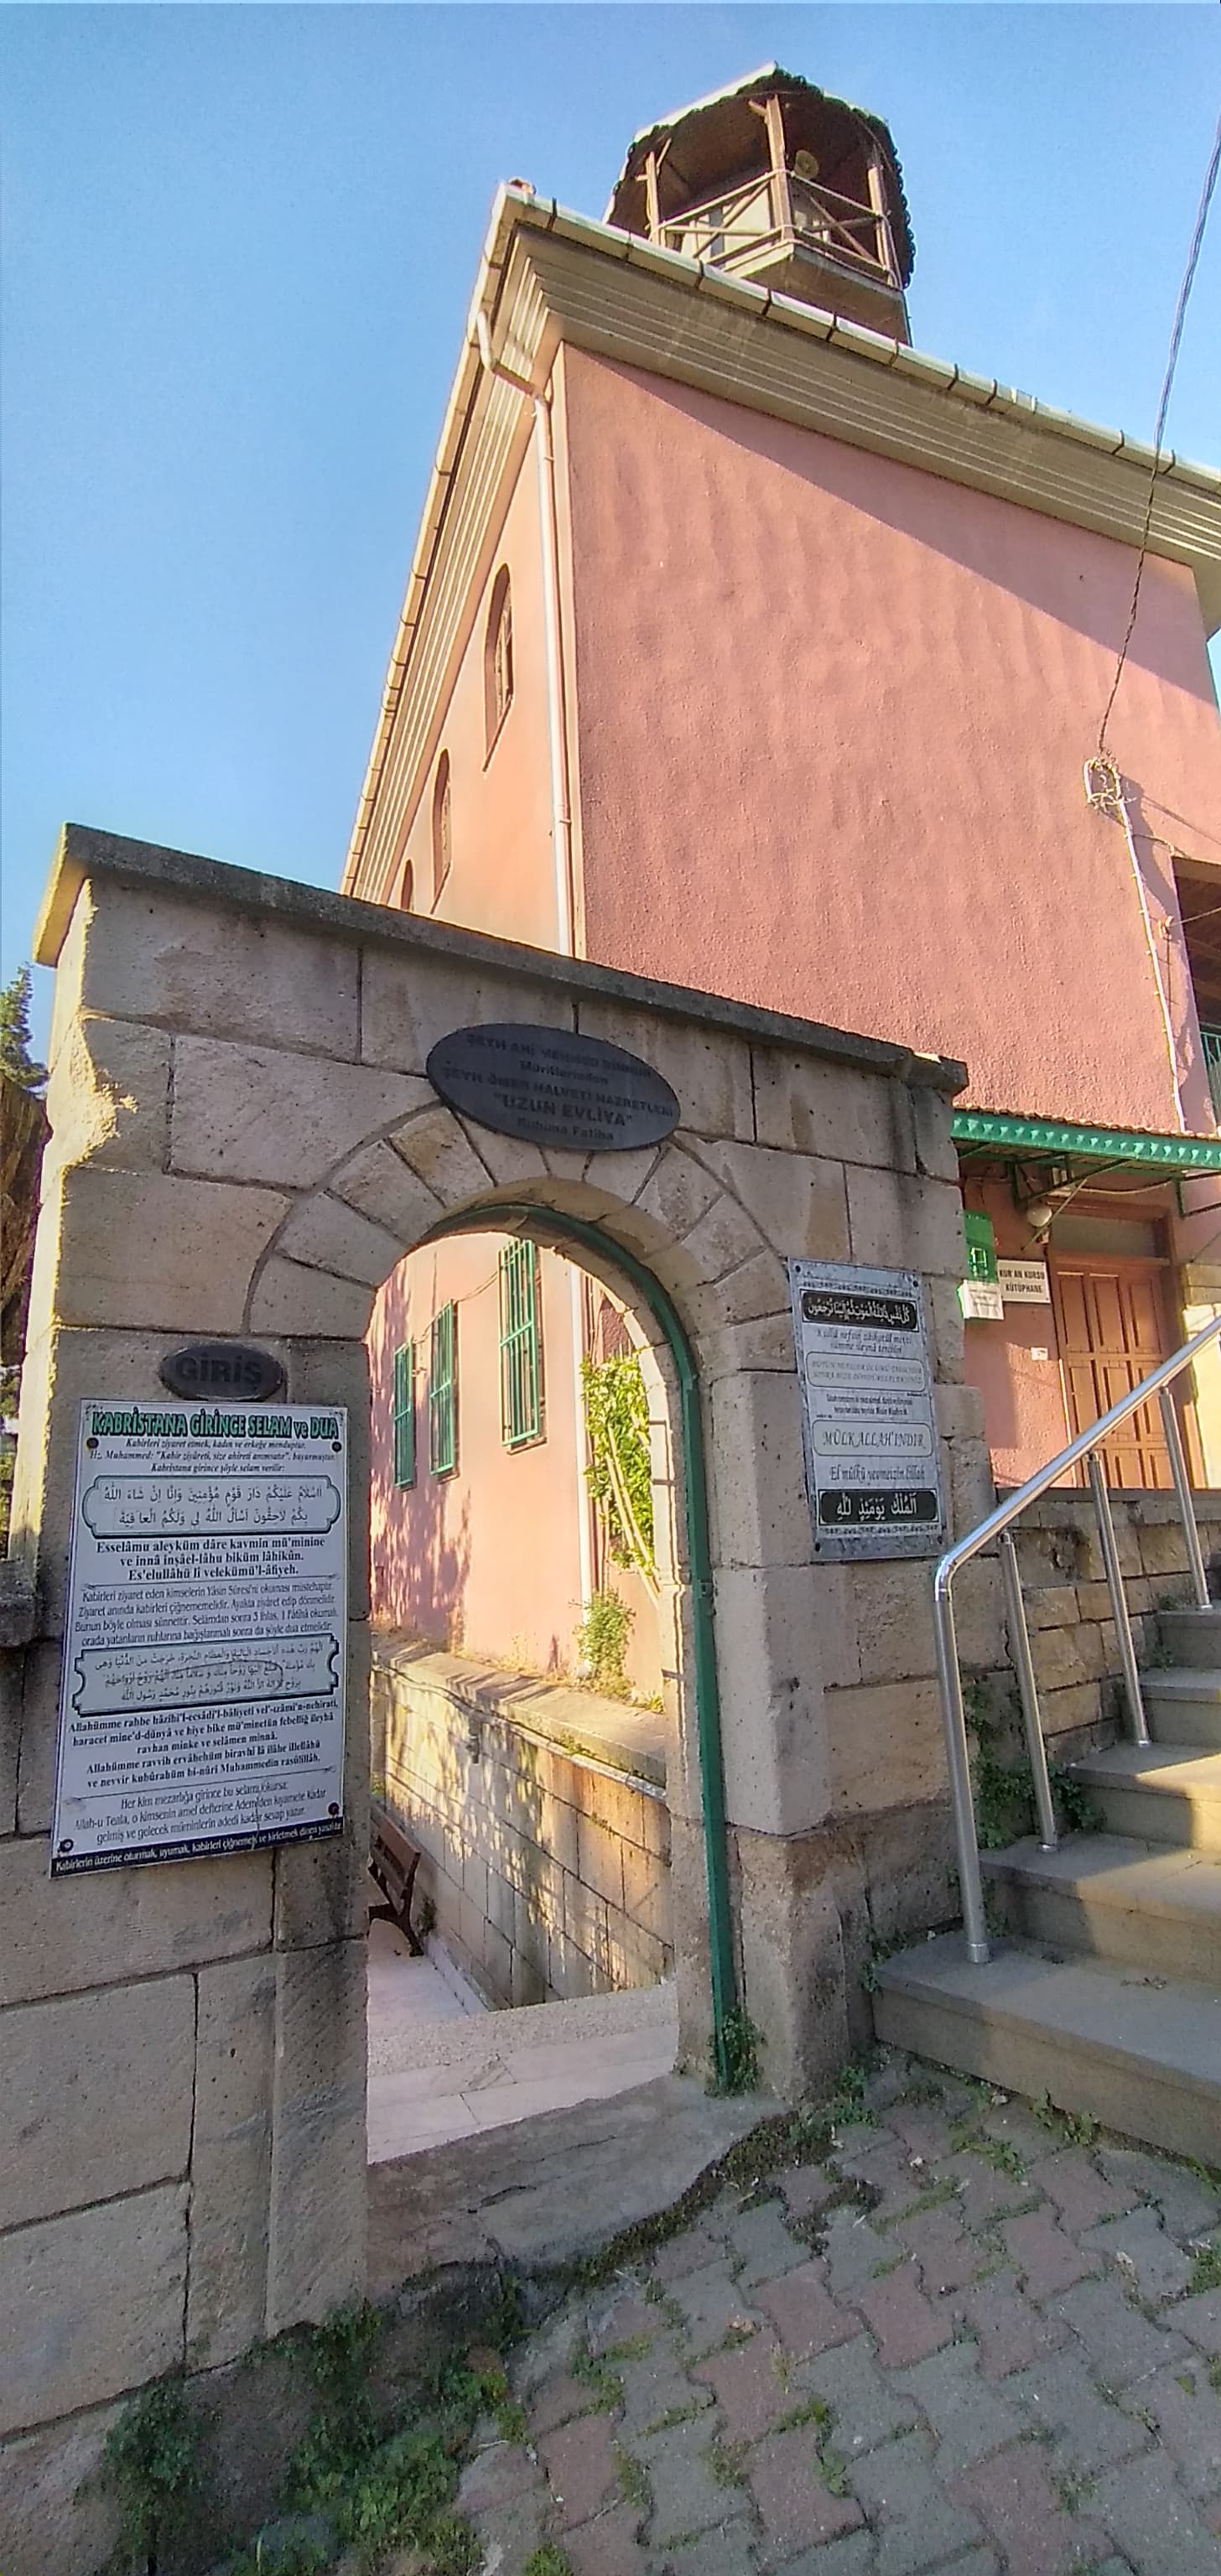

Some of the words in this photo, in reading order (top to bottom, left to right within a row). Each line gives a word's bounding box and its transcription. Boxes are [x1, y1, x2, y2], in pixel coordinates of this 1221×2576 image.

[92, 1406, 189, 1437] KABRİSTANA
[190, 1409, 247, 1438] GİRİNCE
[248, 1415, 293, 1439] SELAM
[294, 1420, 309, 1439] ve
[310, 1416, 340, 1440] DUA
[96, 1540, 149, 1553] Esselâmu
[203, 1538, 227, 1550] dâre
[120, 1558, 132, 1566] ve
